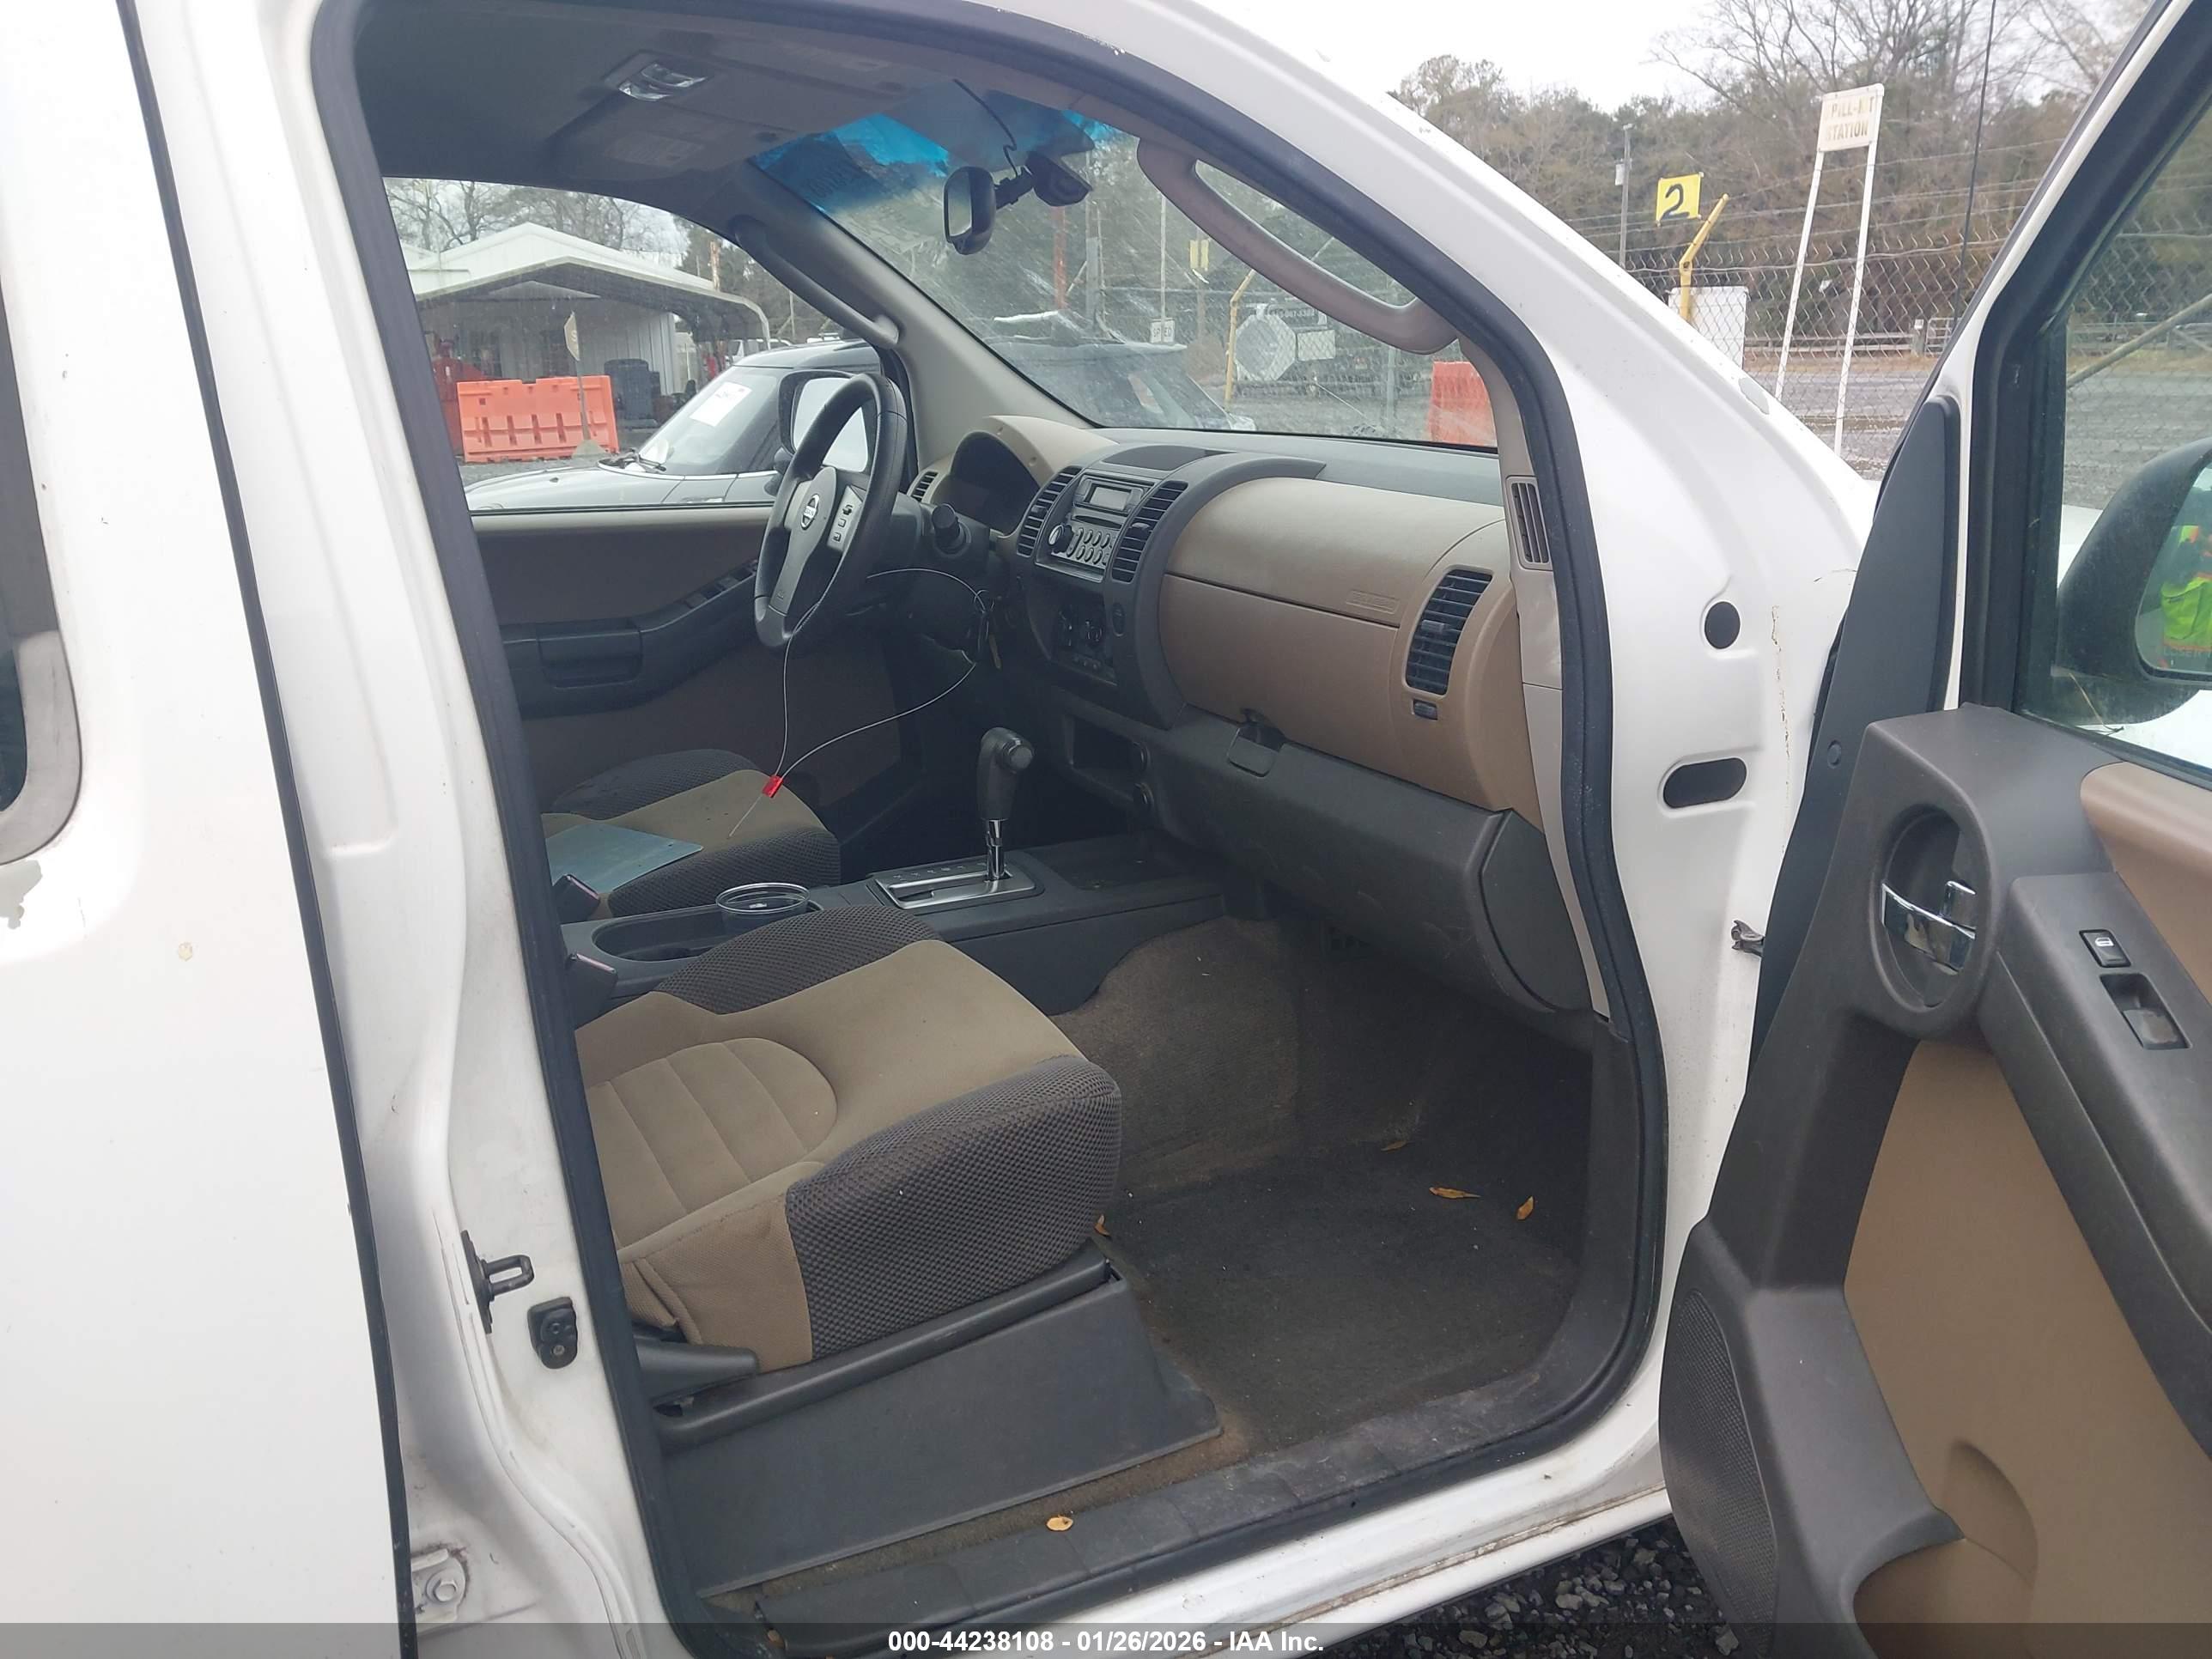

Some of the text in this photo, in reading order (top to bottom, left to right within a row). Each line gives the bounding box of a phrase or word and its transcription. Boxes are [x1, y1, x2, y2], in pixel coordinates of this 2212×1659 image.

[1826, 119, 1869, 141] STATION
[1661, 183, 1690, 220] 2
[1153, 327, 1172, 337] SPED
